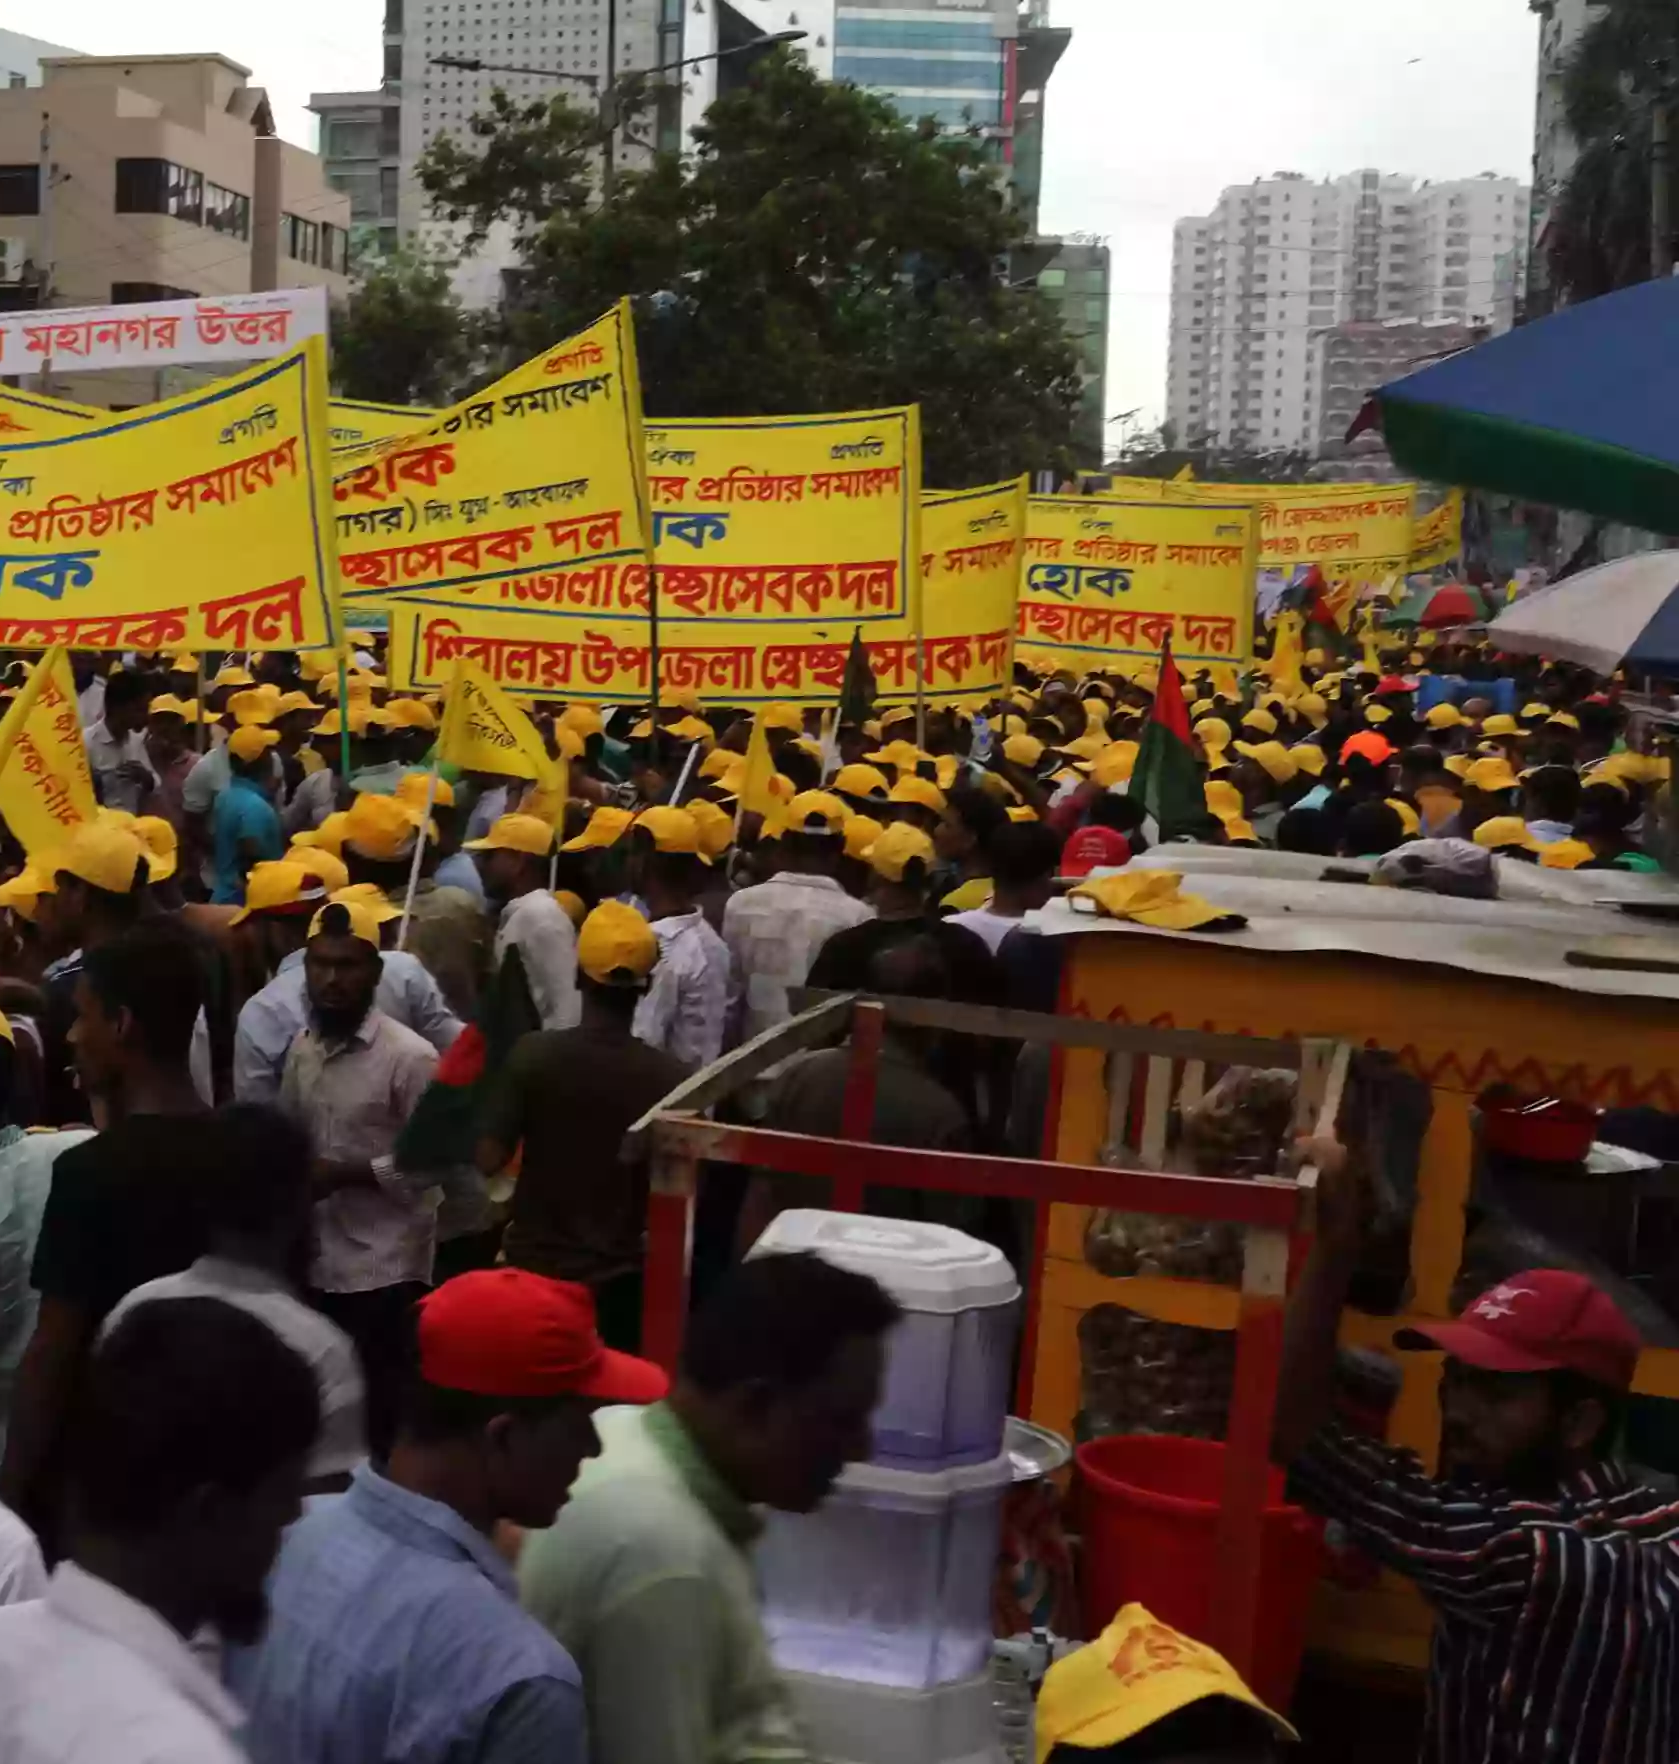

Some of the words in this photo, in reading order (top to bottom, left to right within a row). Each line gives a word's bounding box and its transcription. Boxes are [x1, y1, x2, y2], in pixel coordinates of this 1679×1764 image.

[22, 313, 182, 356] মহানগর
[194, 303, 293, 346] উত্তর
[501, 372, 614, 418] সমাবেশ
[218, 402, 278, 446] প্রগতি
[8, 494, 159, 544] প্রতিষ্ঠার
[165, 435, 299, 515] সমাবেশ
[695, 465, 808, 504] প্রতিষ্ঠার
[809, 464, 901, 501] সমাবেশ
[338, 524, 536, 588] চ্ছাসেবক
[544, 510, 623, 555] দল
[1072, 534, 1159, 565] প্রতিষ্ঠার
[620, 563, 835, 616] স্বেচ্ছাসেবক
[833, 560, 898, 612] দল
[1028, 563, 1135, 600] হোক
[198, 576, 307, 649] দল
[1016, 600, 1175, 650] চ্ছাসেবক
[1181, 614, 1237, 654] দল
[422, 618, 578, 688] শিবালয়
[580, 629, 757, 690] উপজেলা
